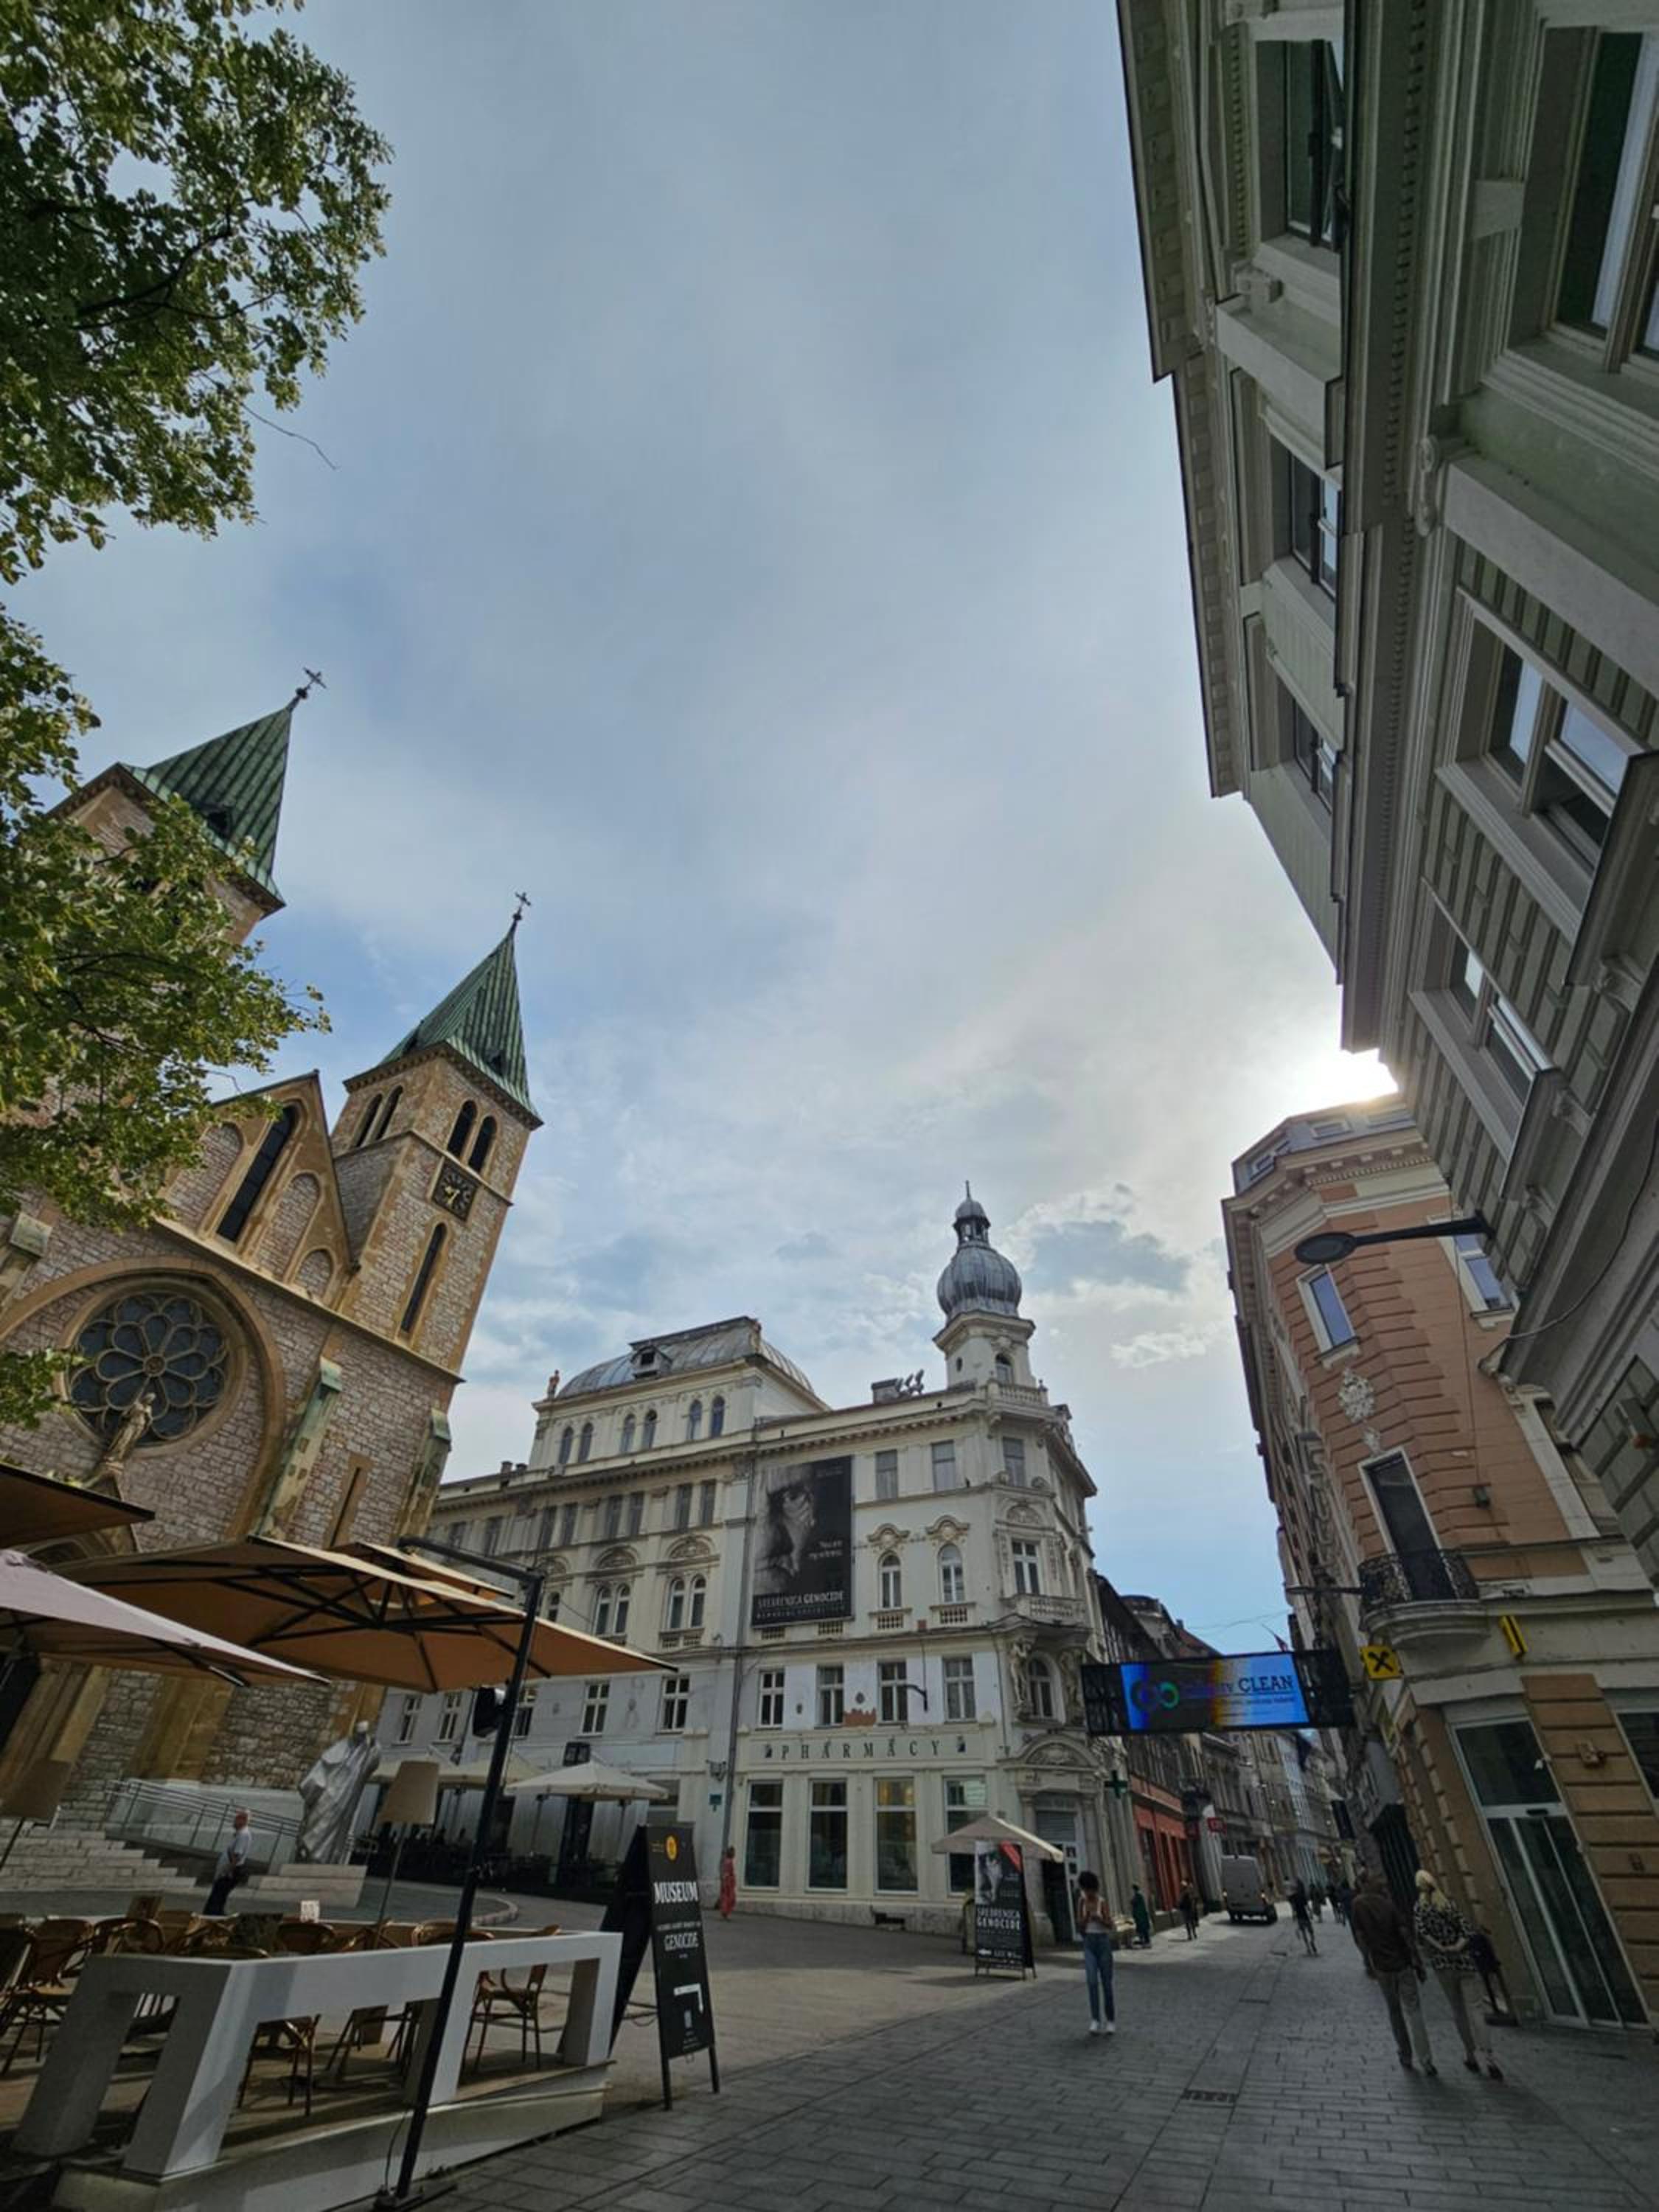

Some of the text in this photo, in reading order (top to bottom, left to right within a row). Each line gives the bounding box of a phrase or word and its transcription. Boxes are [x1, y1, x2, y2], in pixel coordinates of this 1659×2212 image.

[1238, 1674, 1293, 1692] CLEAN
[782, 1739, 939, 1760] PHARMACY
[654, 1881, 699, 1904] MUSEUM
[977, 1918, 1020, 1930] GENOCIDE
[664, 1932, 700, 1951] GENOCIDE
